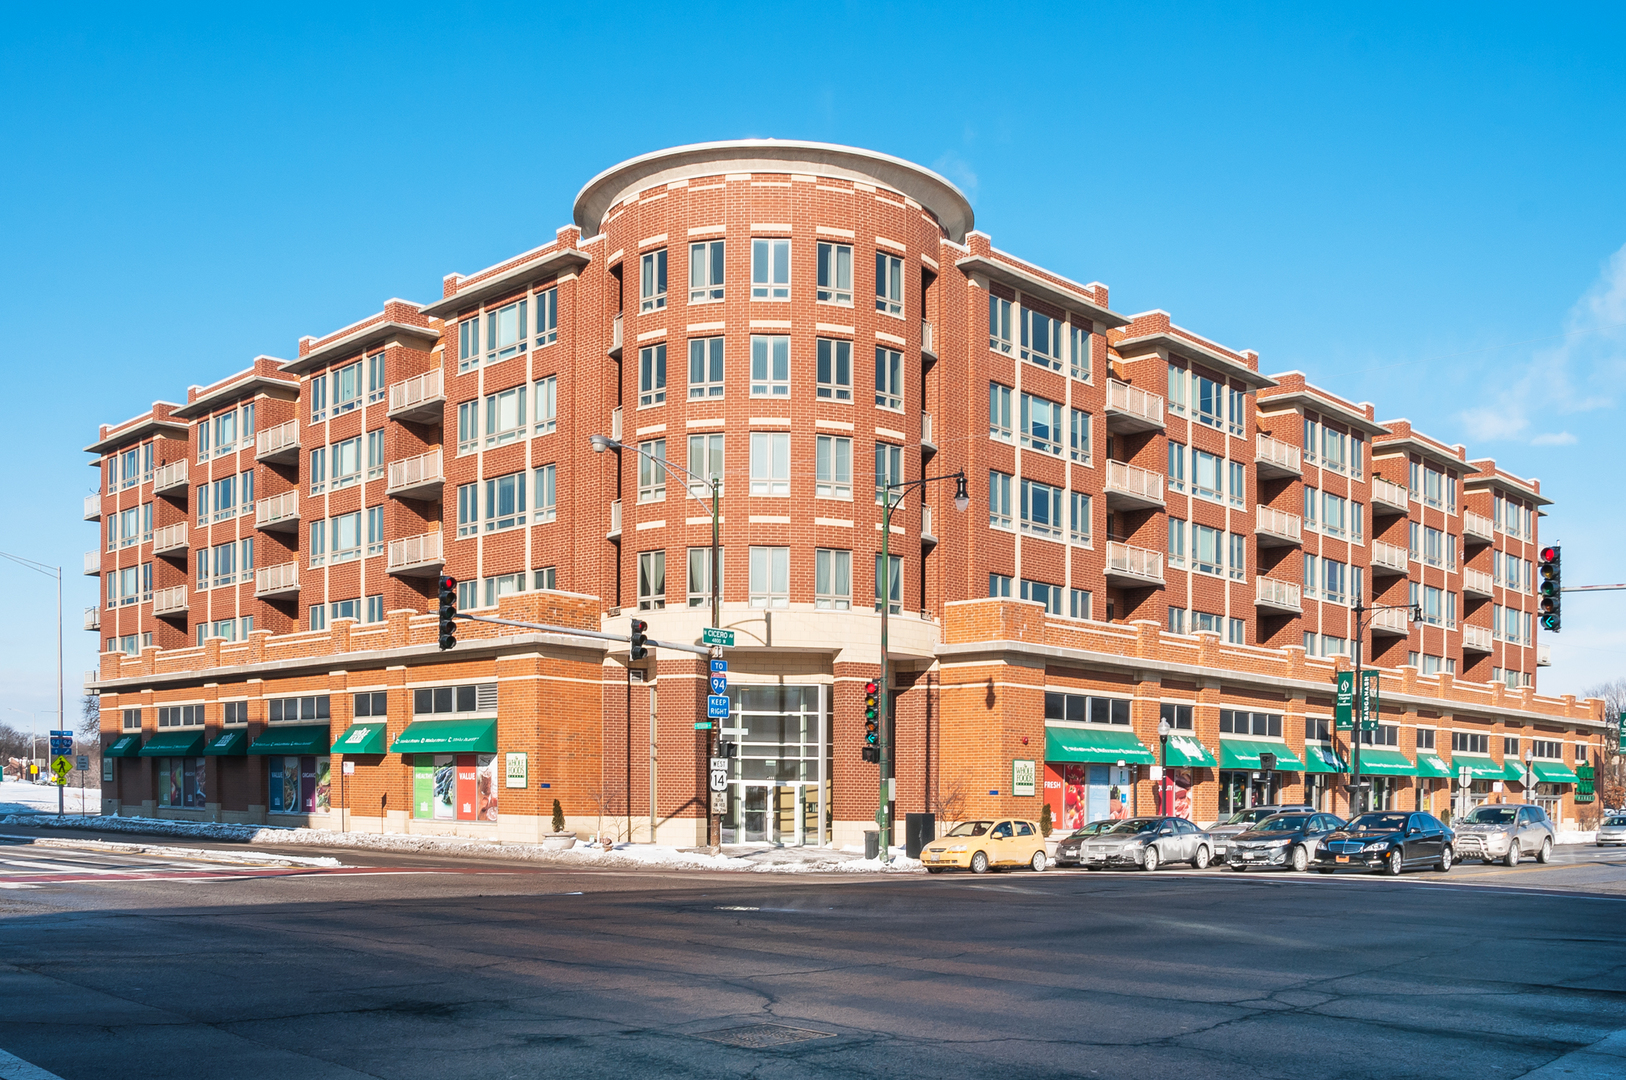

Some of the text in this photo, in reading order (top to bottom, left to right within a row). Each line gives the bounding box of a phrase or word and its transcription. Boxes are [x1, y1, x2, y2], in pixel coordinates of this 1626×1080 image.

[708, 630, 728, 639] CICERO
[713, 678, 725, 690] 94
[508, 759, 524, 768] WHOLE
[508, 766, 524, 774] FOODS
[714, 774, 724, 786] 14
[1016, 773, 1033, 782] FOODS
